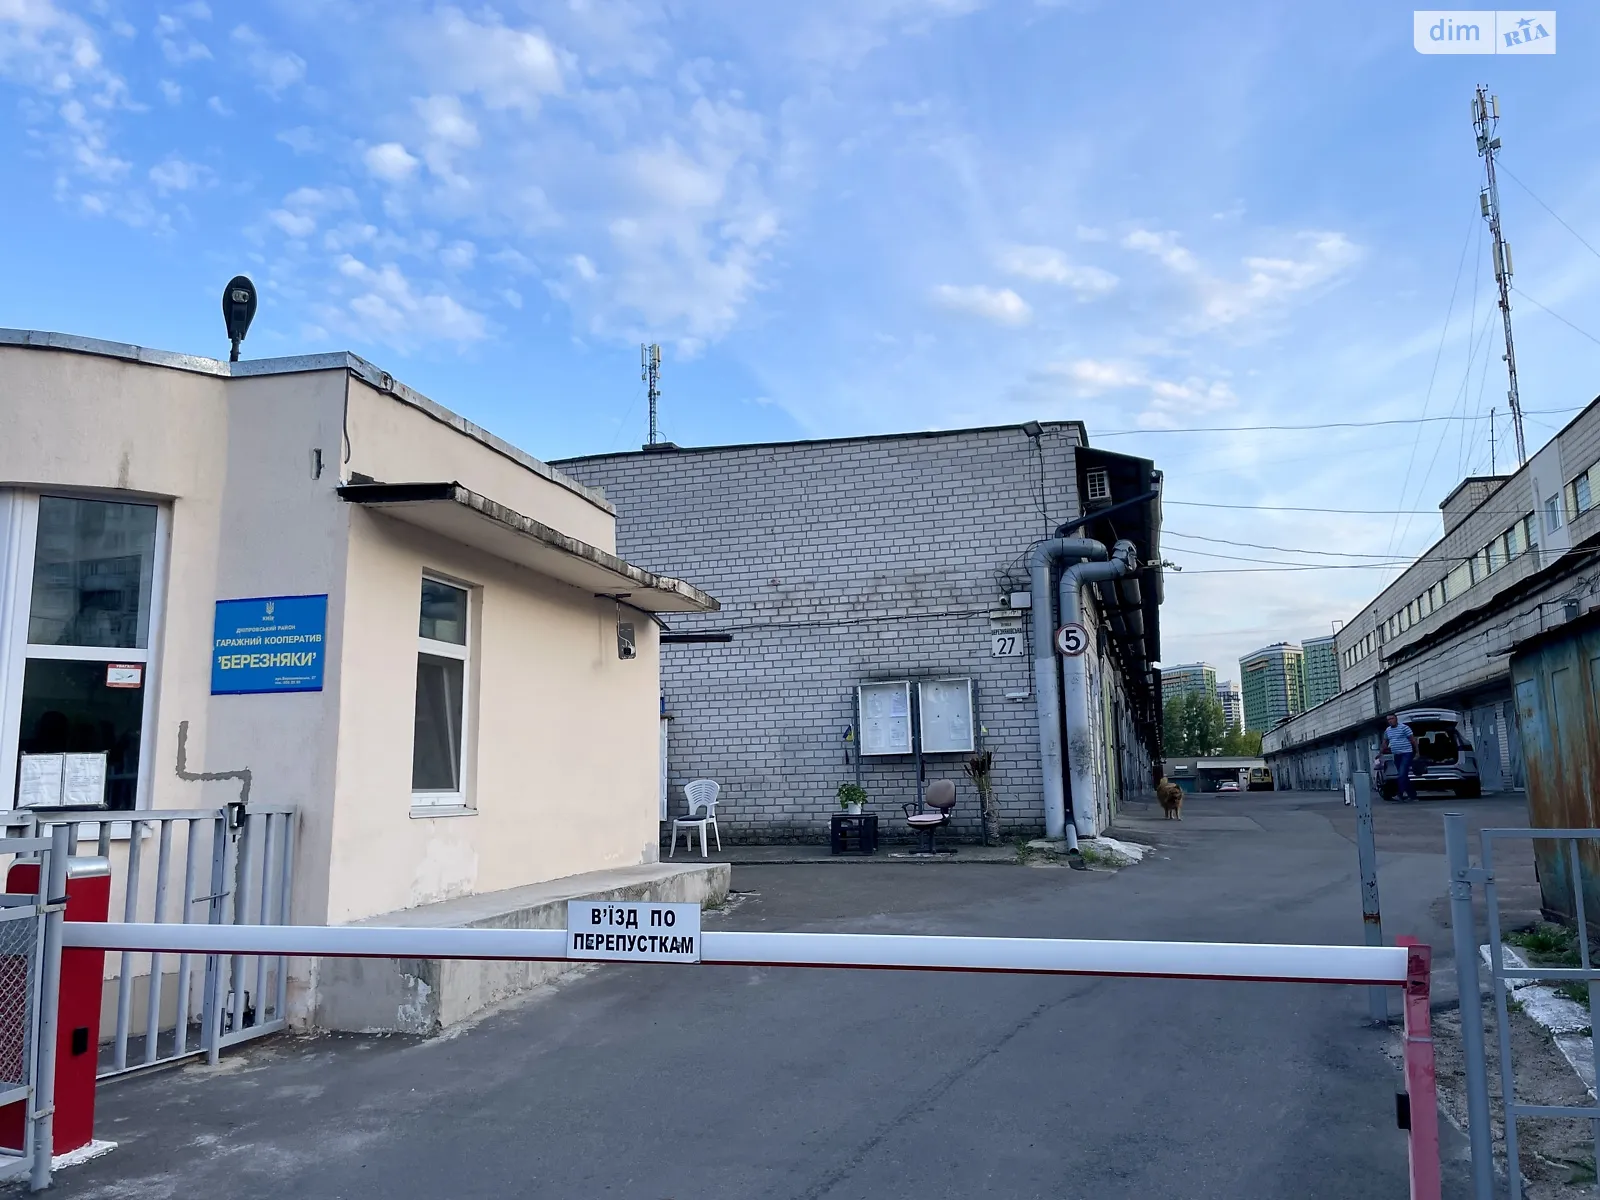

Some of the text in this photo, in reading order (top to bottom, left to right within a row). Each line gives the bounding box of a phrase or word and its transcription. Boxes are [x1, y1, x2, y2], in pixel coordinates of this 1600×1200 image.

[216, 634, 322, 647] ГАРАЖНИЙ КООПЕРАТИВ
[997, 637, 1016, 655] 27
[1065, 629, 1081, 651] 5
[591, 905, 676, 929] В'ЇЗД ПО
[573, 933, 694, 954] ПЕРЕПУСТКАМ
